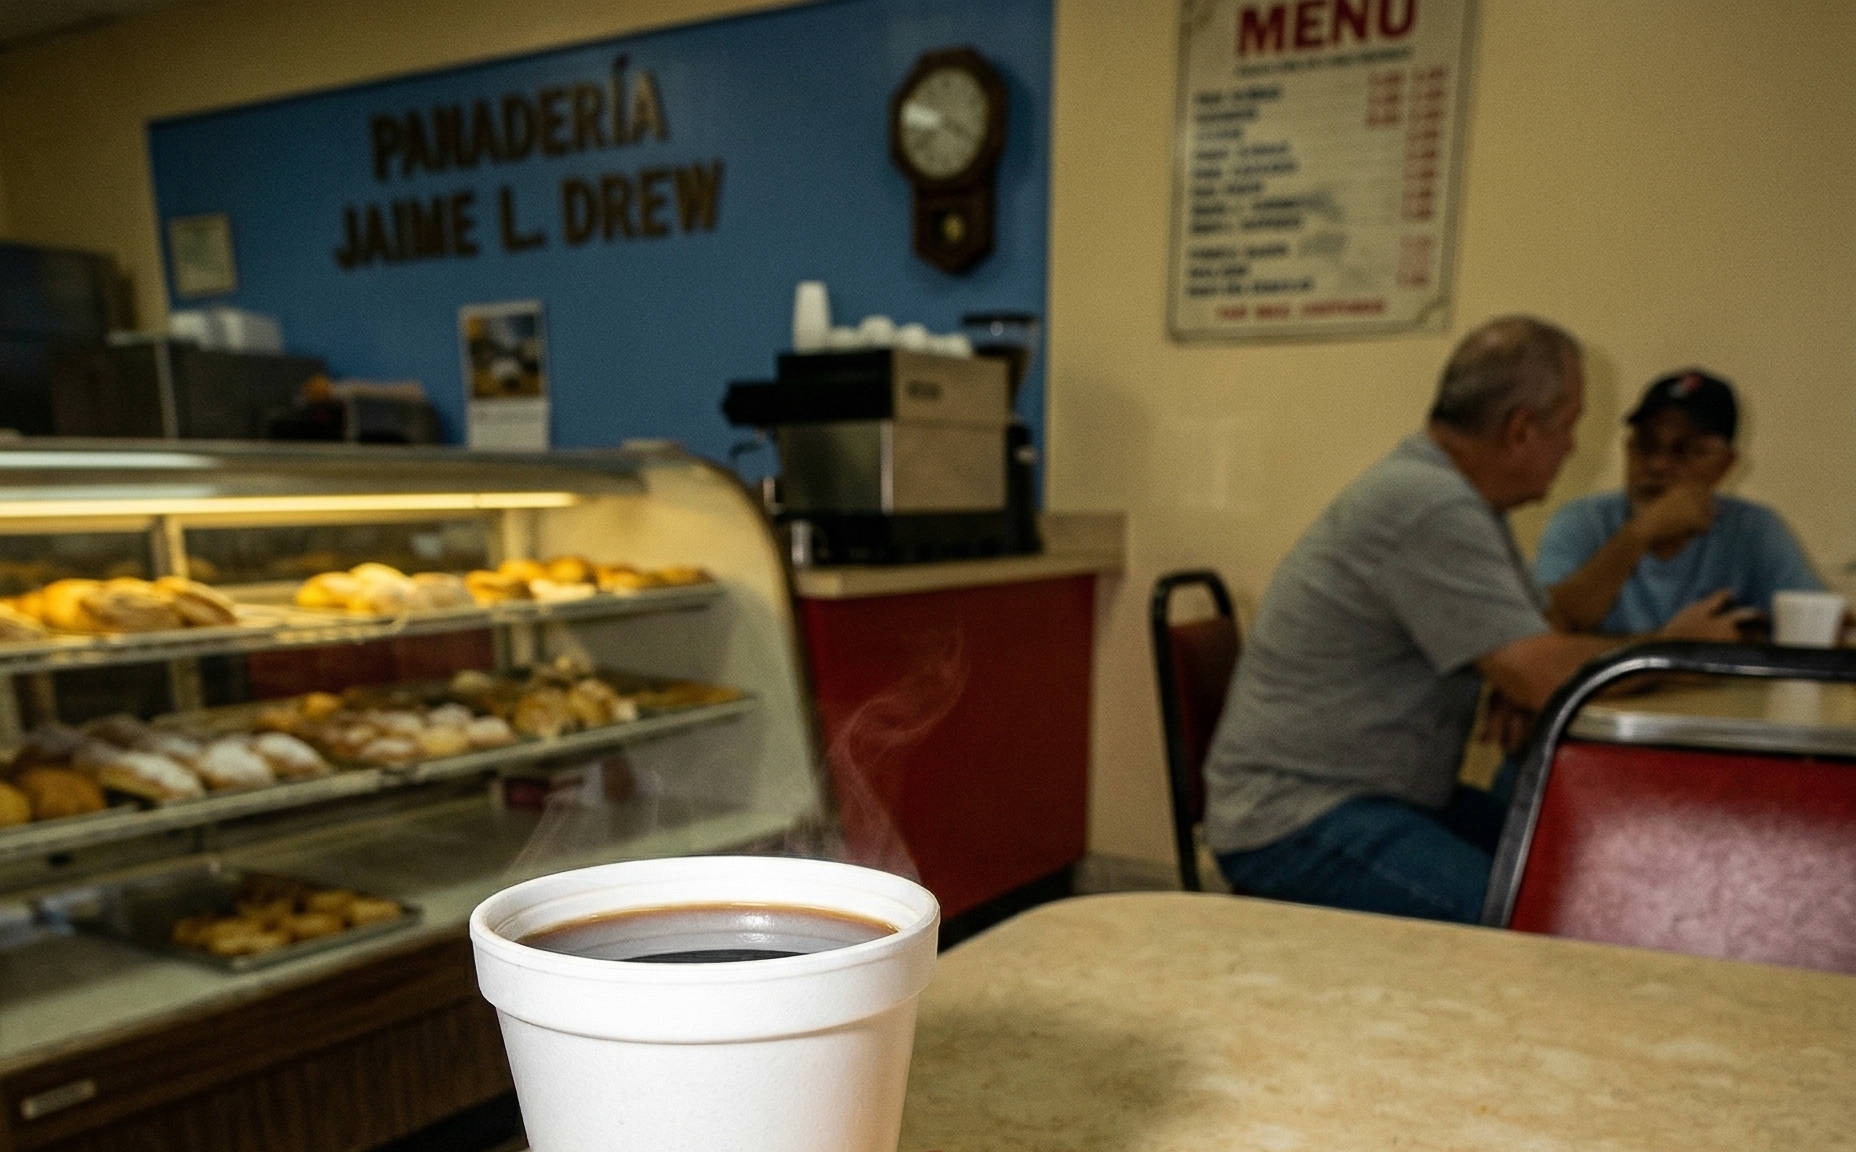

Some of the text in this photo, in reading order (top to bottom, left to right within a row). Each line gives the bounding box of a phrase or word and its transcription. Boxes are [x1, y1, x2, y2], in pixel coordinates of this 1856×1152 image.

[1237, 0, 1414, 56] MENU
[335, 189, 479, 271] JAIME
[561, 157, 723, 248] DREW
